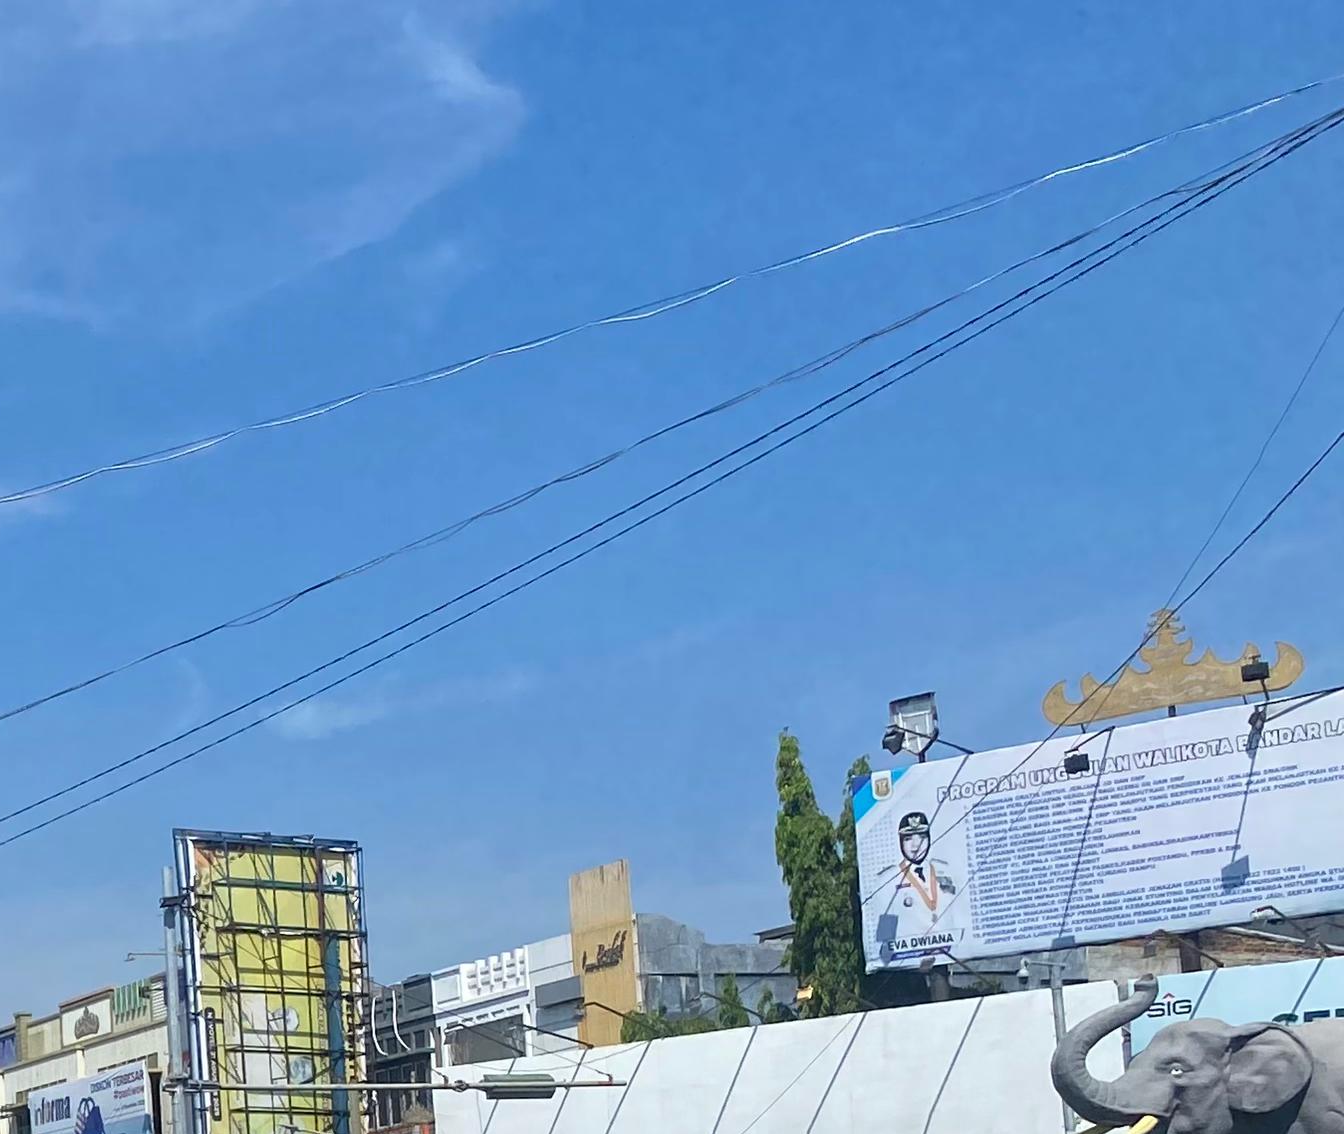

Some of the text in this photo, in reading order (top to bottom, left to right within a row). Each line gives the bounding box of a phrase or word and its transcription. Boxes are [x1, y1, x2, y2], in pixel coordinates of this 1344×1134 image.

[937, 771, 1026, 803] PROGRAM
[1134, 737, 1233, 768] WALIKOTA
[888, 933, 954, 951] EVA DWIANA
[1147, 999, 1192, 1018] SIG
[113, 1069, 144, 1087] TERBESAR
[35, 1096, 70, 1126] informa
